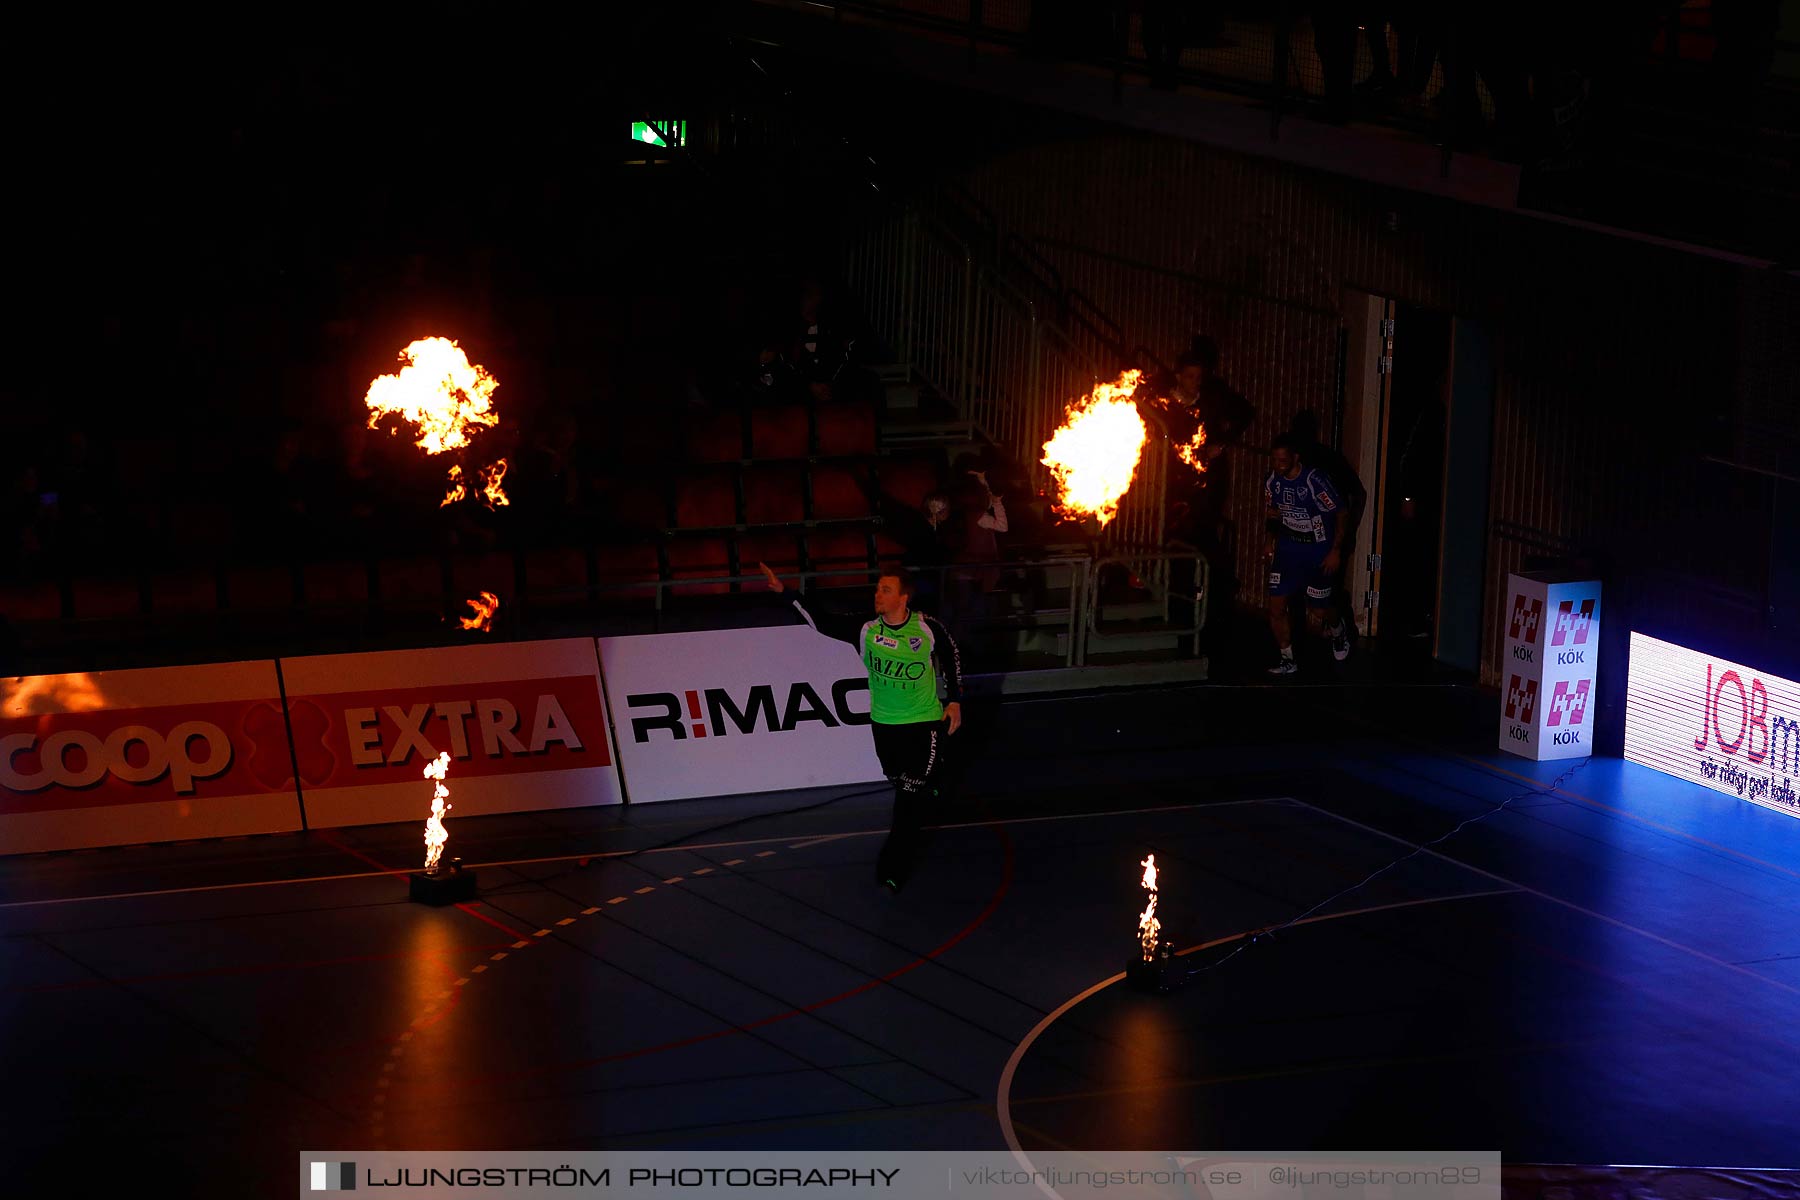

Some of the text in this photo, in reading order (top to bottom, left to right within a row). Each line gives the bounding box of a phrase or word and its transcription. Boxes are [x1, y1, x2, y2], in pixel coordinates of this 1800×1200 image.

[1513, 645, 1533, 663] KÖK
[1558, 648, 1584, 665] KÖK
[345, 694, 583, 769] EXTRA
[1509, 724, 1529, 743] KÖK
[1553, 730, 1580, 746] KÖK
